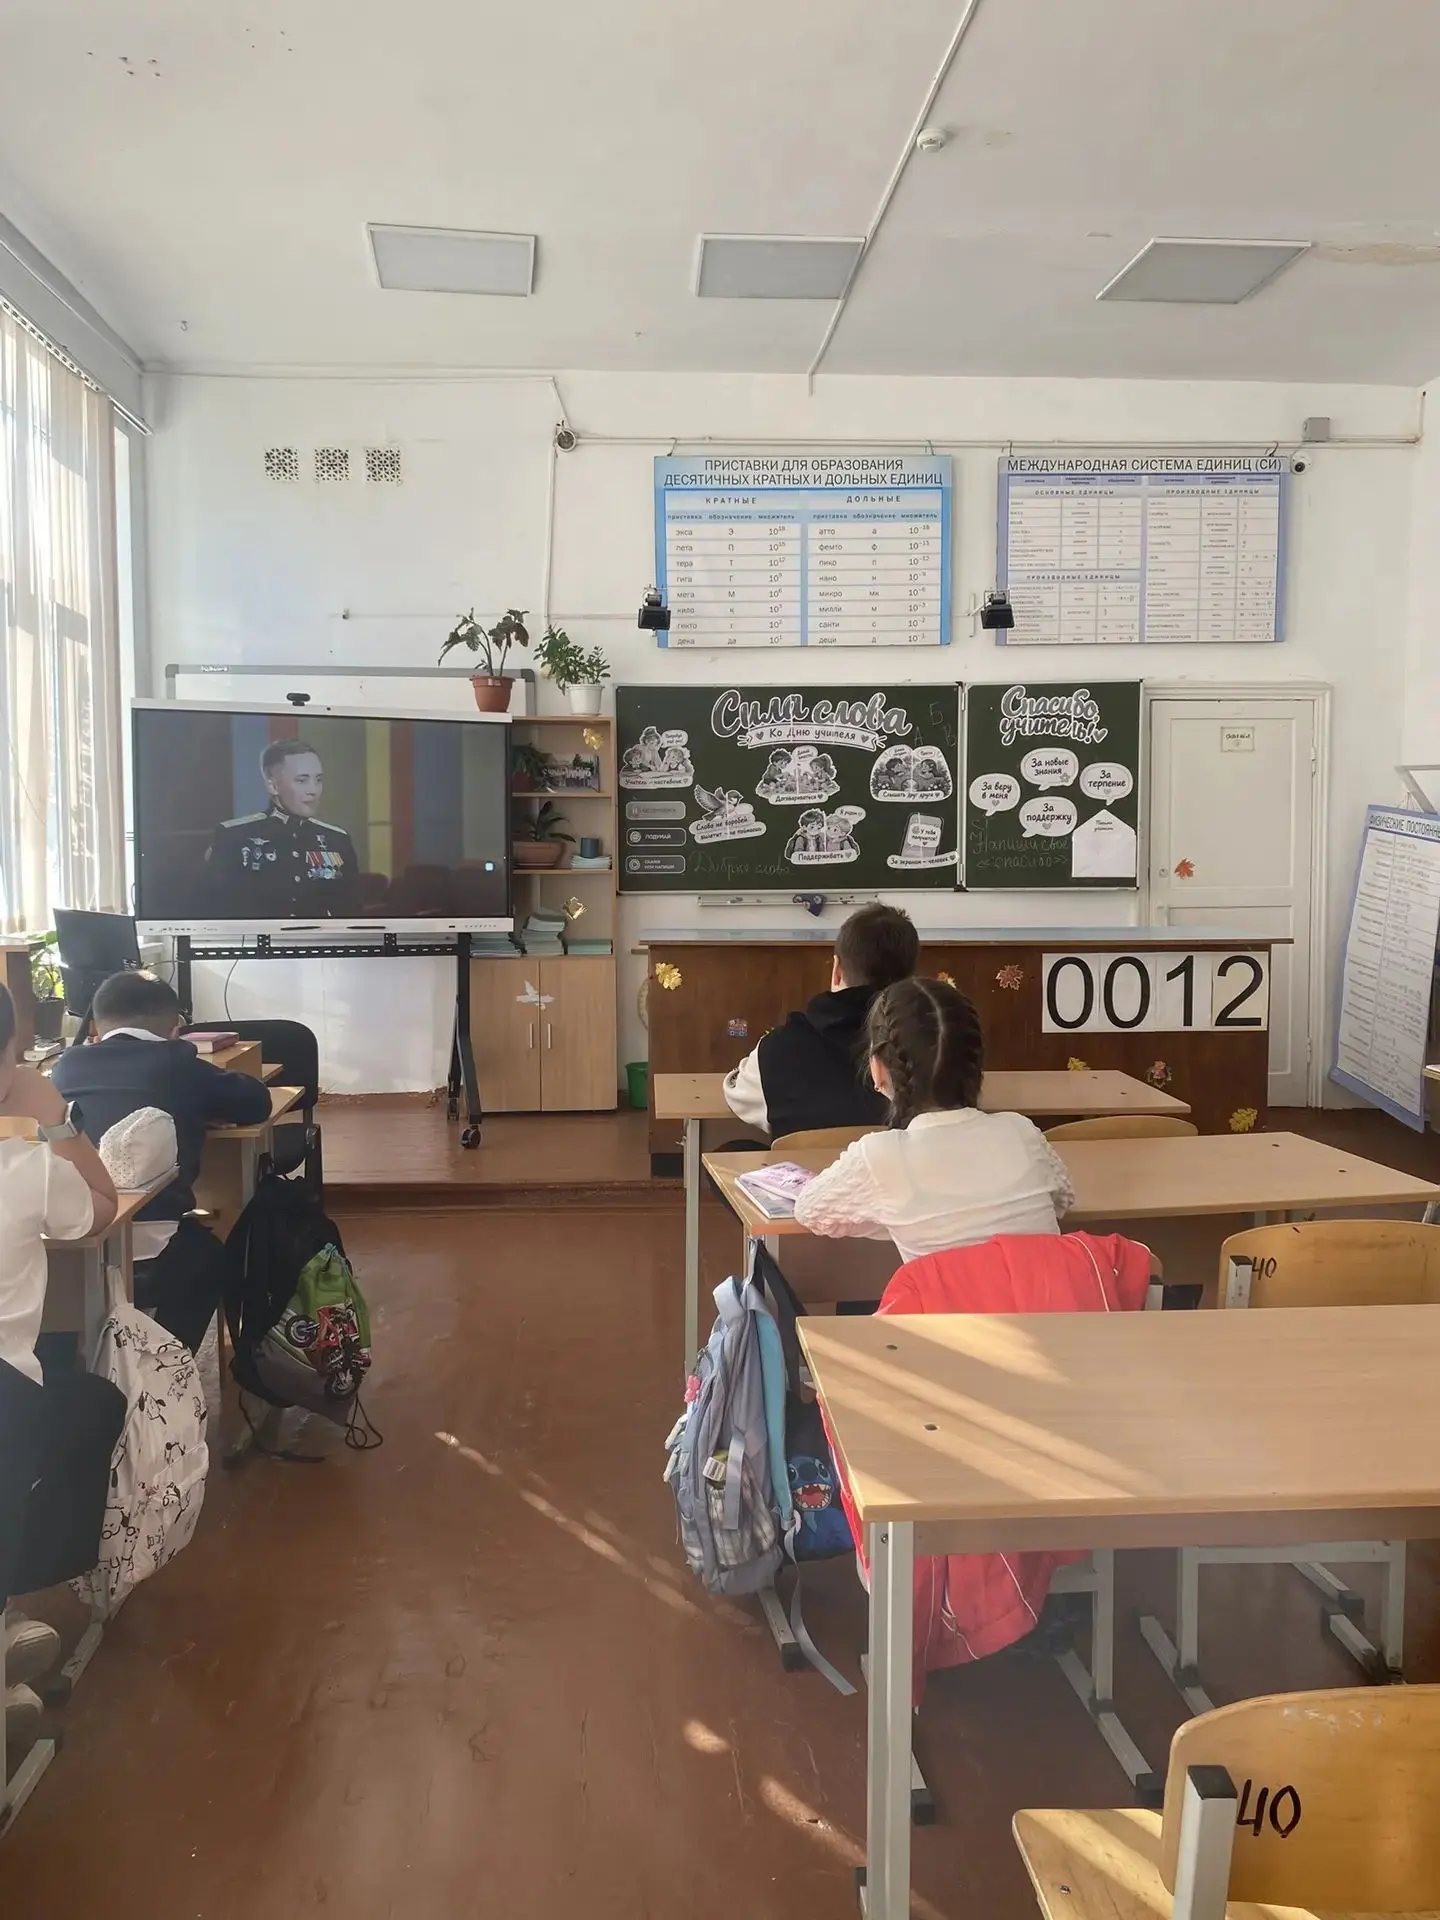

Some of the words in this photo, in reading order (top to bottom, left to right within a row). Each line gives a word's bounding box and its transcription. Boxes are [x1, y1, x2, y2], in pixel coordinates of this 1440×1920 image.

[705, 460, 779, 471] ПРИСТАВКИ
[782, 460, 807, 472] ДЛЯ
[811, 459, 903, 471] ОБРАЗОВАНИЯ
[1007, 459, 1127, 472] МЕЖДУНАРОДНАЯ
[1131, 459, 1193, 471] СИСТЕМА
[1197, 459, 1252, 472] ЕДИНИЦ
[1255, 458, 1282, 472] (СИ)
[664, 474, 750, 487] ДЕСЯТИЧНЫХ
[753, 474, 810, 485] КРАТНЫХ
[813, 474, 822, 485] И
[825, 473, 887, 486] ДОЛЬНЫХ
[890, 473, 943, 486] ЕДИНИЦ
[705, 497, 757, 505] КРАТНЫЕ
[846, 495, 901, 503] ДОЛЬНЫЕ
[711, 690, 809, 738] Сила
[811, 692, 912, 736] слова
[769, 728, 783, 738] Ко
[786, 728, 810, 738] Дню
[814, 729, 856, 741] учителя
[999, 716, 1096, 745] учитель!
[1031, 758, 1043, 767] За
[1044, 757, 1069, 766] новые
[1034, 767, 1062, 776] знания
[1100, 770, 1111, 779] За
[981, 782, 992, 791] За
[994, 782, 1012, 793] веру
[1088, 779, 1126, 790] терпение
[989, 792, 1009, 800] меня
[1042, 803, 1054, 812] За
[1026, 813, 1072, 825] поддержку
[696, 823, 714, 831] Слово
[1046, 955, 1264, 1029] 0012
[1251, 1256, 1277, 1280] 40
[1236, 1779, 1301, 1839] 40
